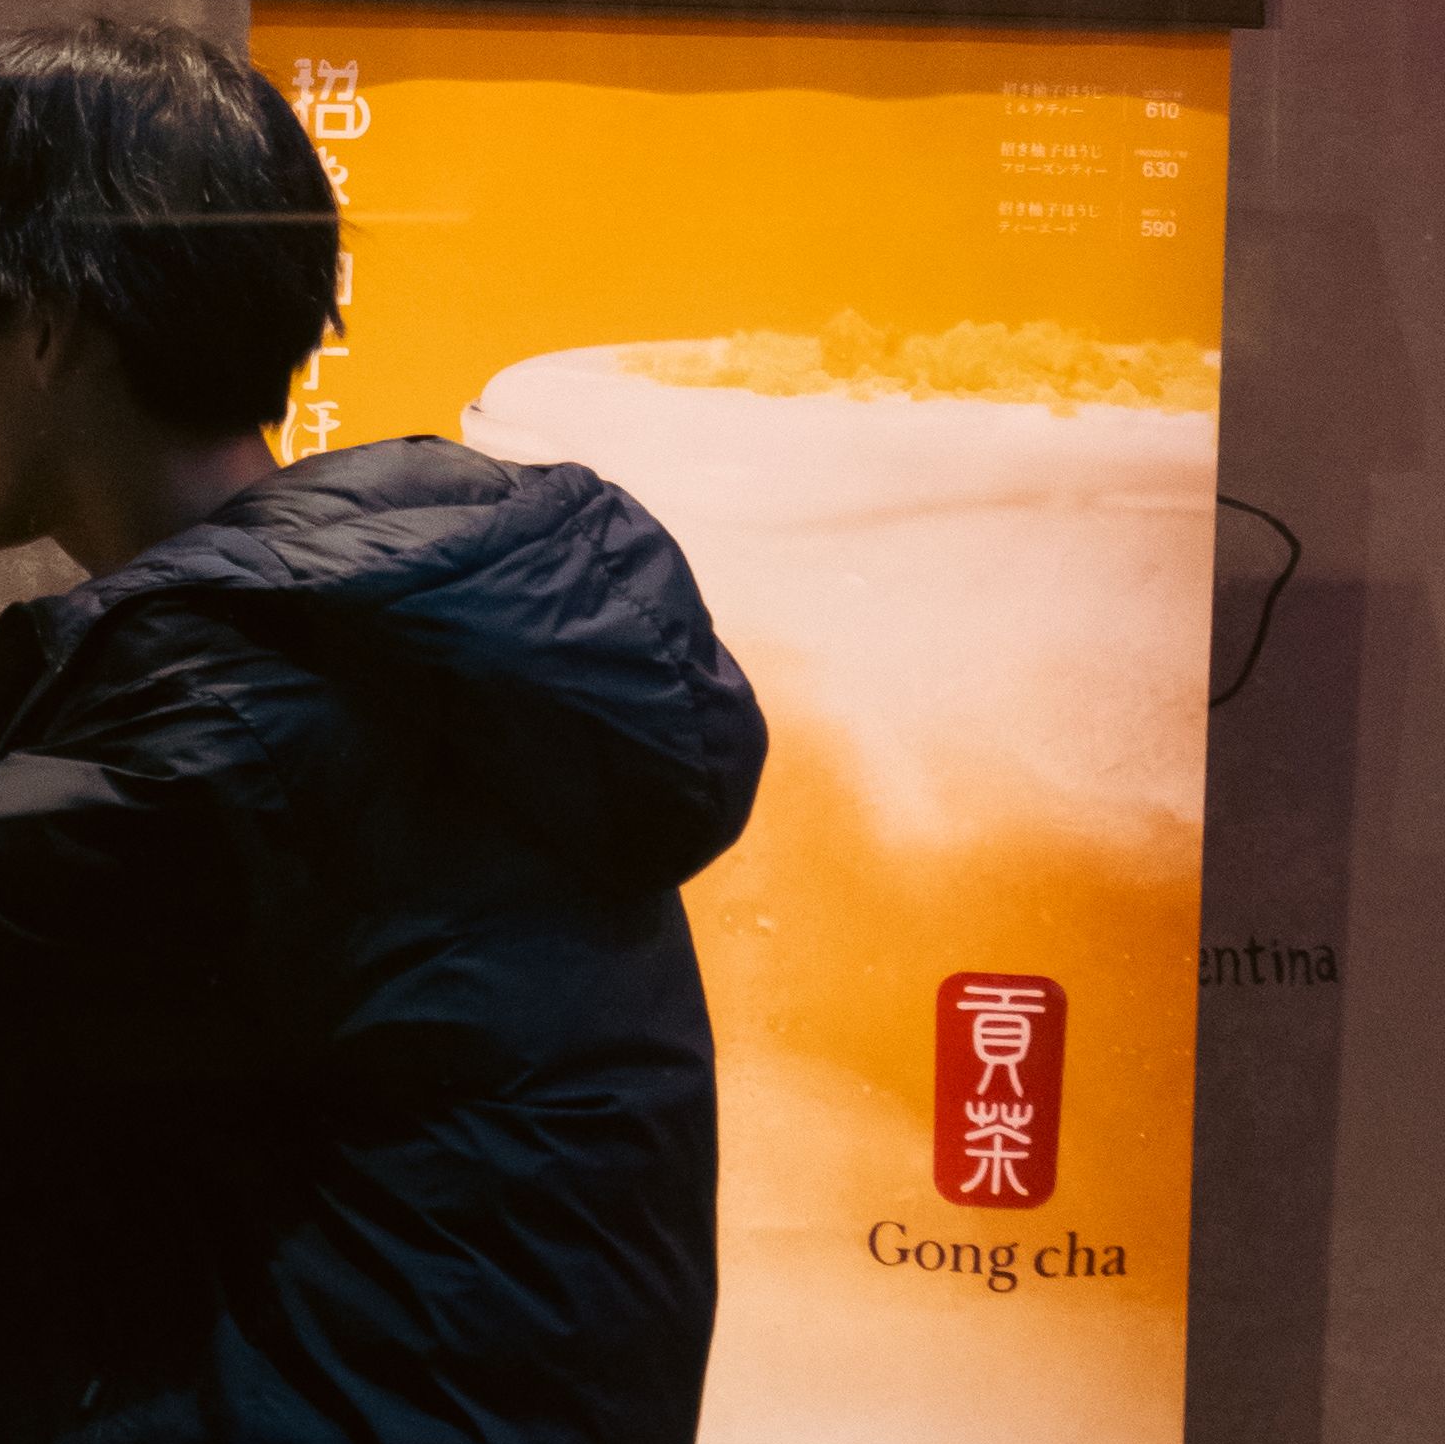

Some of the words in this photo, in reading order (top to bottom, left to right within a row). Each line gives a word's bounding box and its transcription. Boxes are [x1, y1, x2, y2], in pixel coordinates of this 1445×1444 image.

[1145, 101, 1180, 119] 610
[1142, 160, 1178, 178] 630
[1140, 220, 1177, 238] 590
[956, 984, 1047, 1197] 貢茶
[867, 1219, 1018, 1293] Gong
[1033, 1231, 1128, 1278] cha
